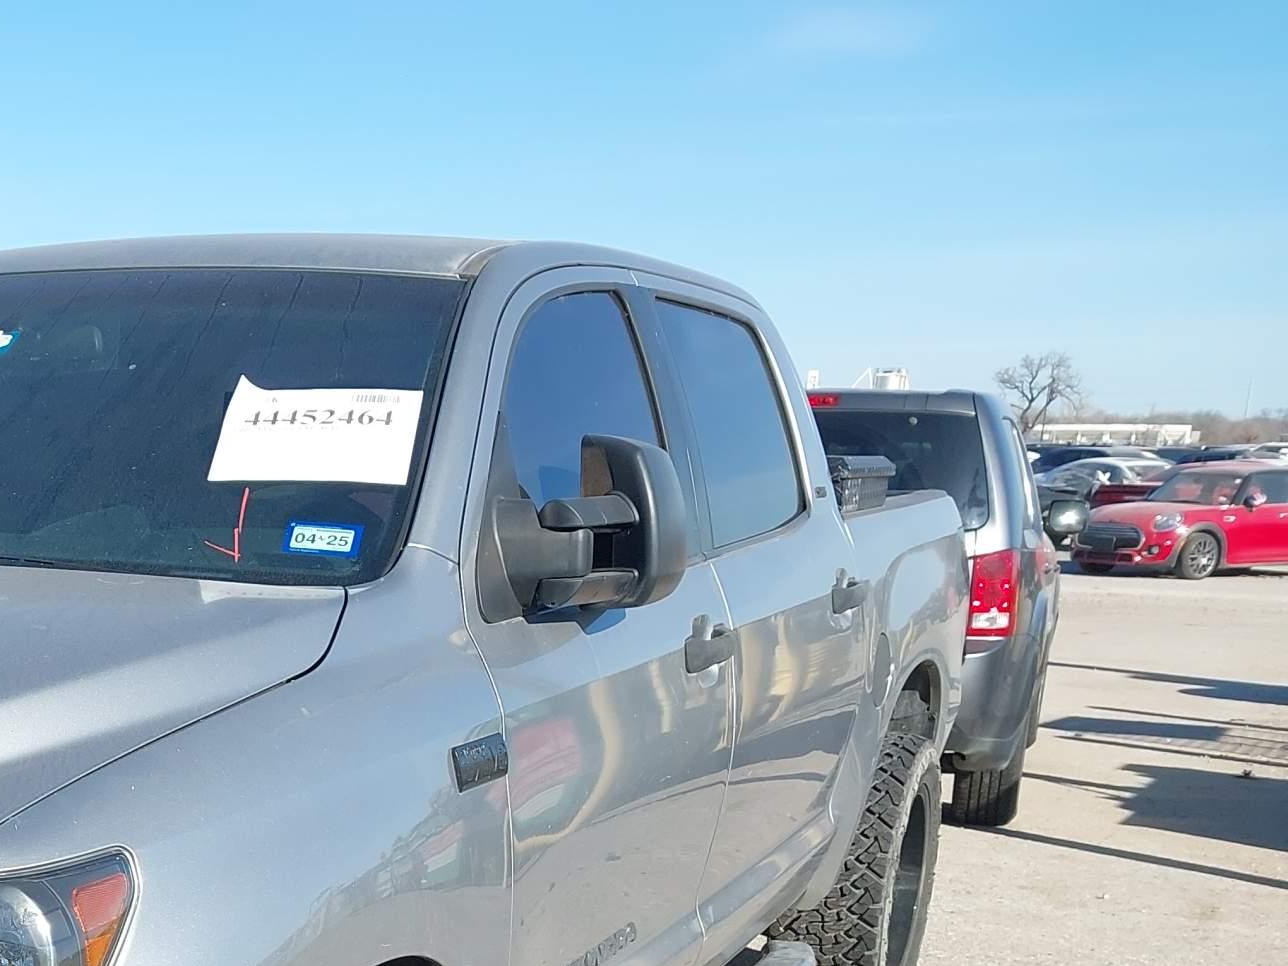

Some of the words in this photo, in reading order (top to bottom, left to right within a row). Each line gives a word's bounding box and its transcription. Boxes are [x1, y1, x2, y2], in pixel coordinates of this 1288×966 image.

[244, 409, 393, 426] 44452464
[294, 532, 316, 544] 04
[326, 534, 350, 547] 25
